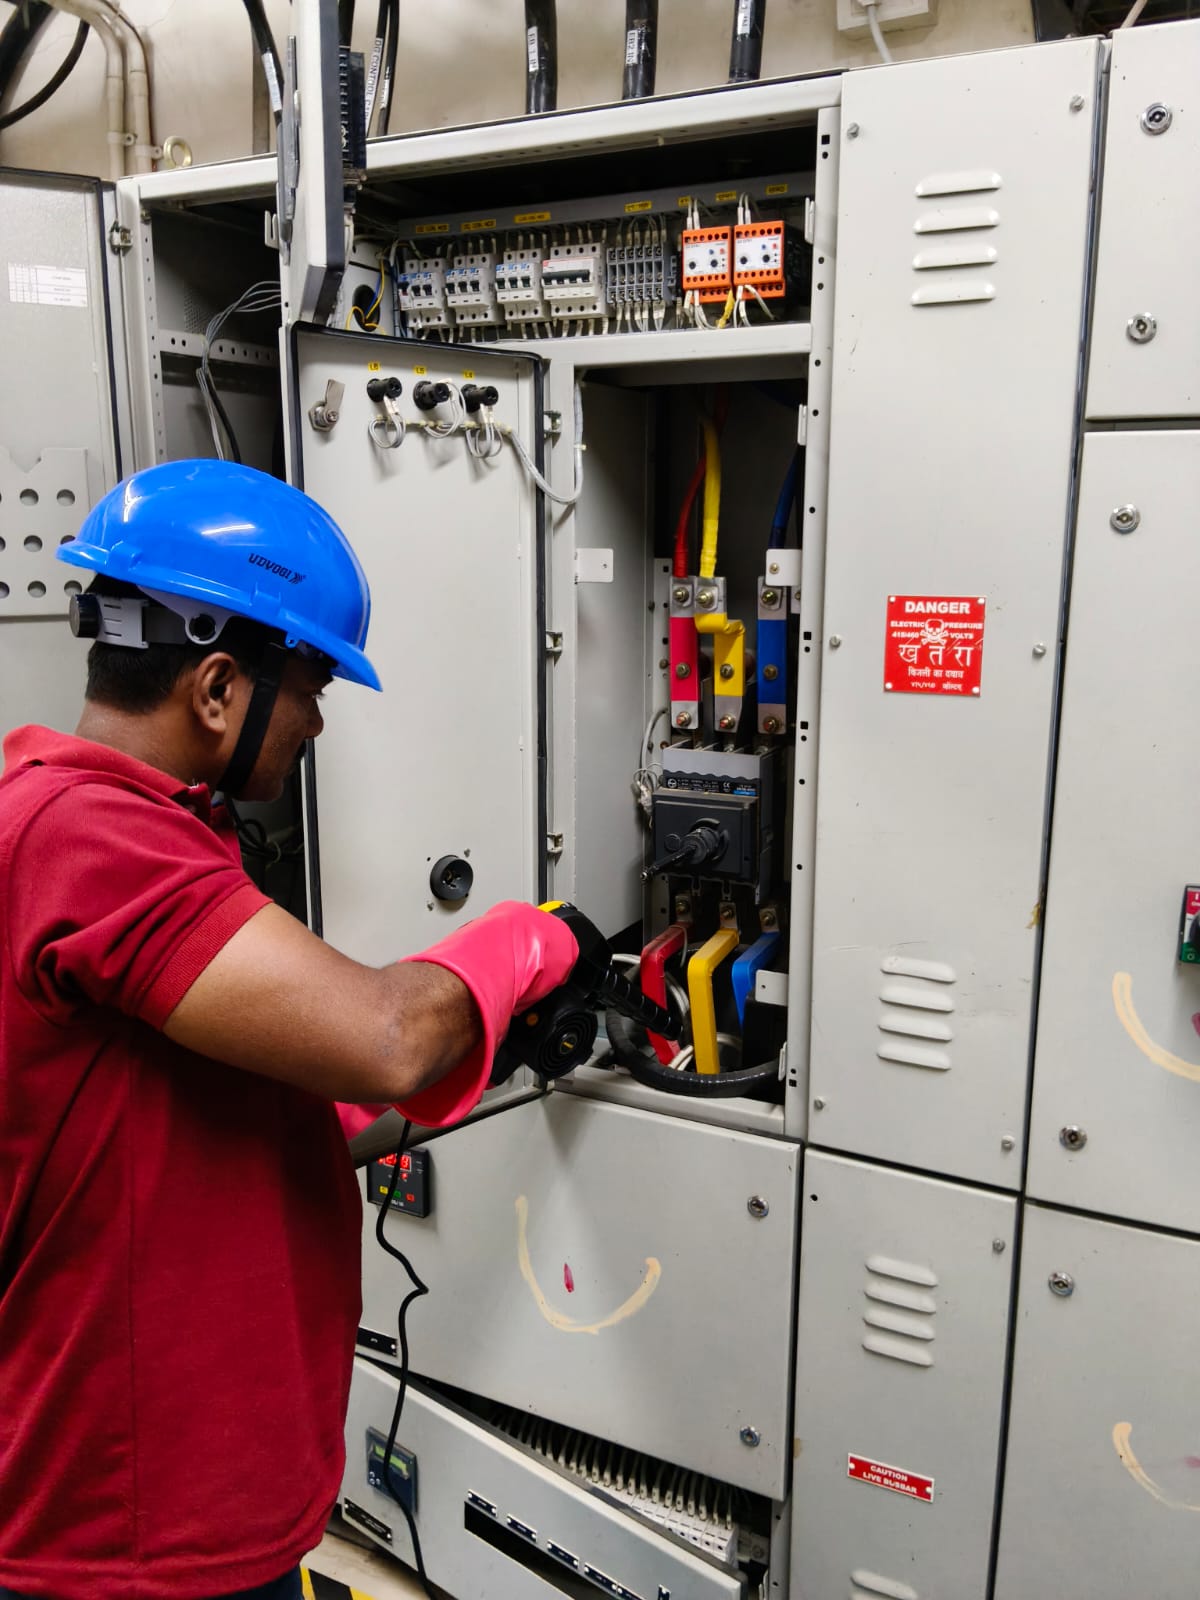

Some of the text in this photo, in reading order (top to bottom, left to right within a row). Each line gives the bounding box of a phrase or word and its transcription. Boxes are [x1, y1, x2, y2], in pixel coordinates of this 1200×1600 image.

[374, 39, 383, 53] DG
[904, 600, 971, 614] DANGER
[890, 620, 983, 630] ELECTRIC PRESSURE
[949, 632, 974, 640] VOLTS
[870, 1465, 908, 1481] CAUTION
[862, 1471, 917, 1494] LIVE BUSBAR
